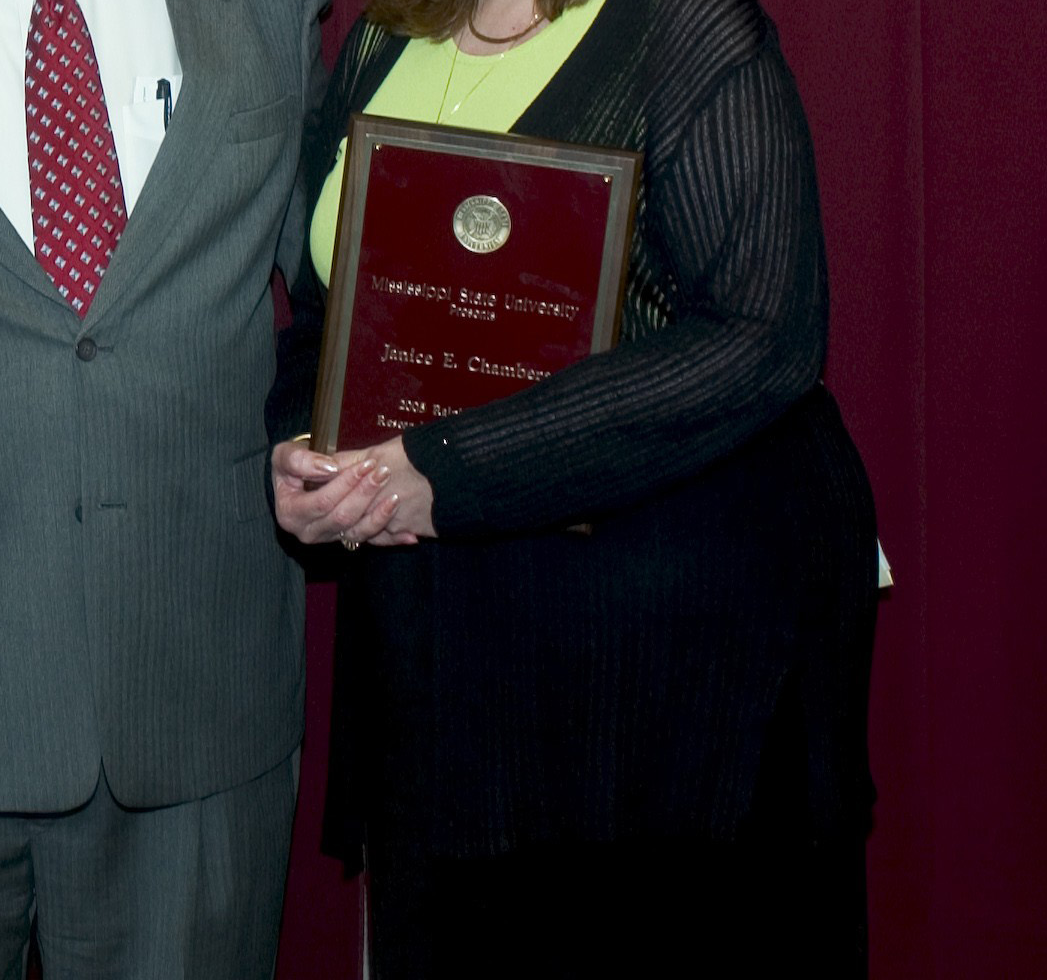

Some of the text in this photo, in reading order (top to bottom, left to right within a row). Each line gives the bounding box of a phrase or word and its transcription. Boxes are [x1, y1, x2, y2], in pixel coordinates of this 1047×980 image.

[372, 275, 580, 321] Mississippi State University
[380, 343, 434, 366] Janice
[443, 351, 458, 369] E.
